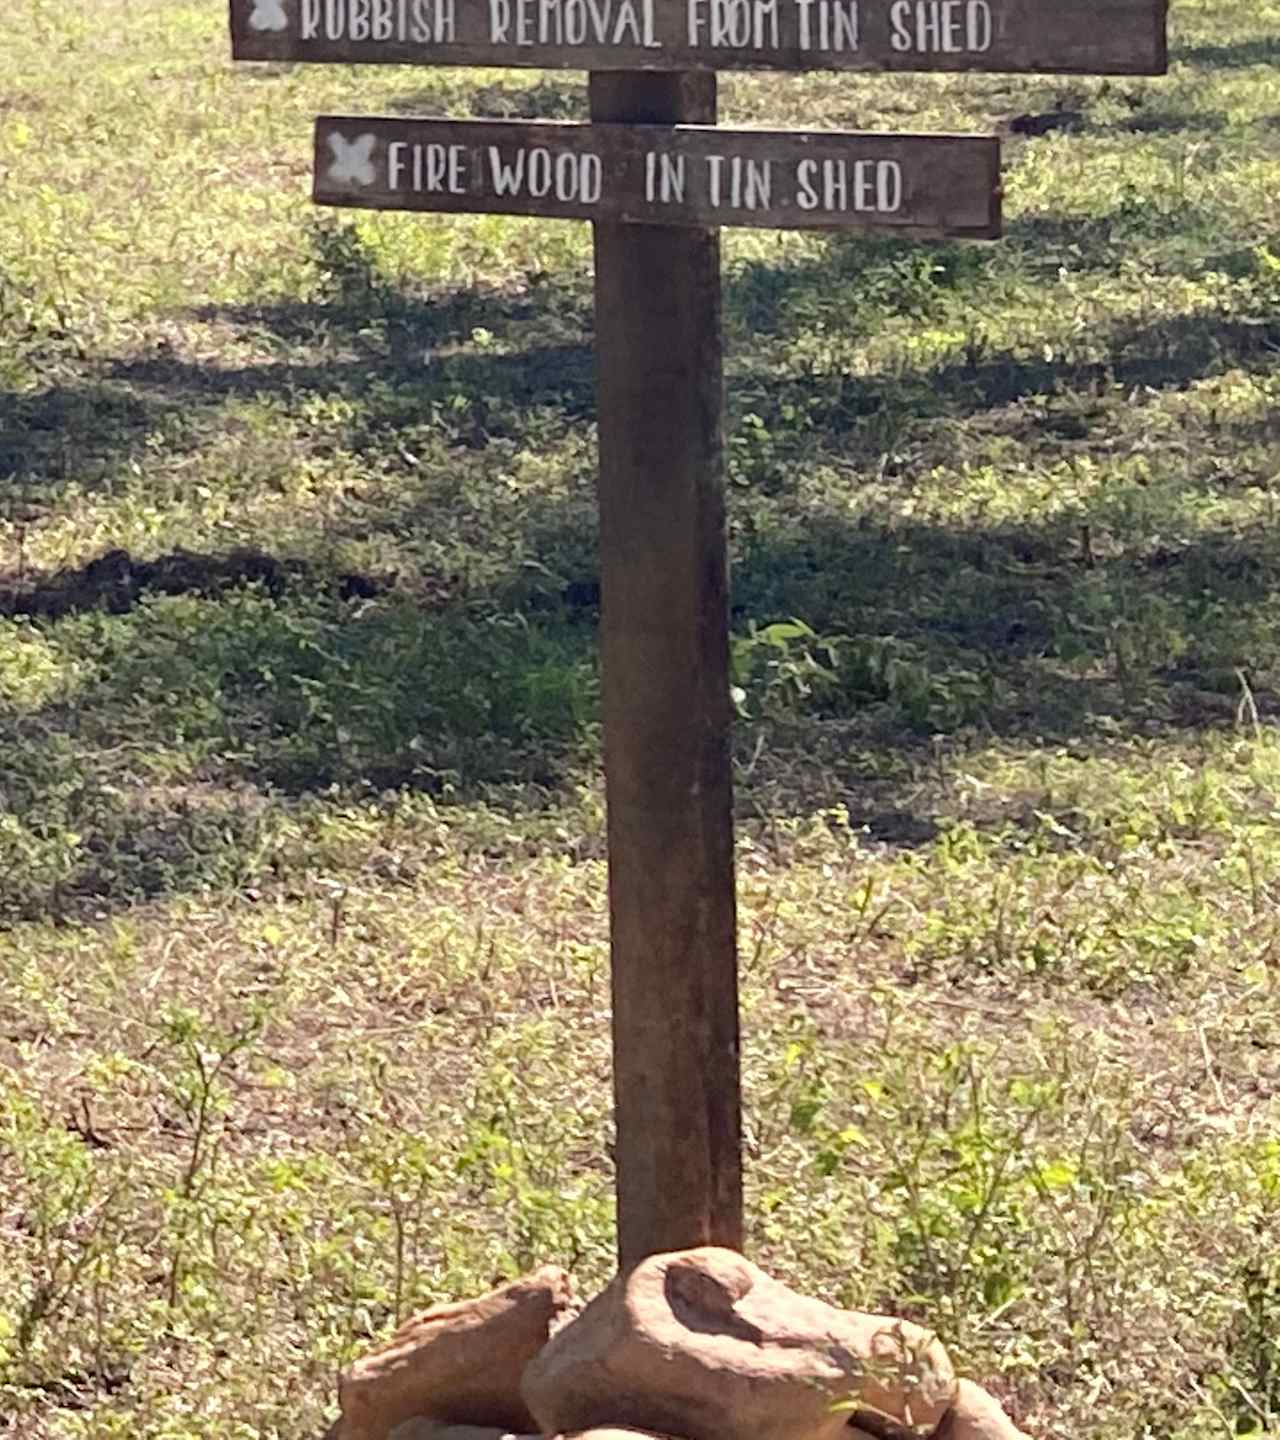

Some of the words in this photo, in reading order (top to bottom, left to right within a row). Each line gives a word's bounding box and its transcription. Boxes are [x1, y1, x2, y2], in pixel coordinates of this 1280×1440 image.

[387, 142, 467, 194] FIRE
[488, 145, 602, 204] WOOD
[645, 151, 685, 203] IN
[704, 154, 772, 211] TIN
[796, 158, 903, 213] SHED
